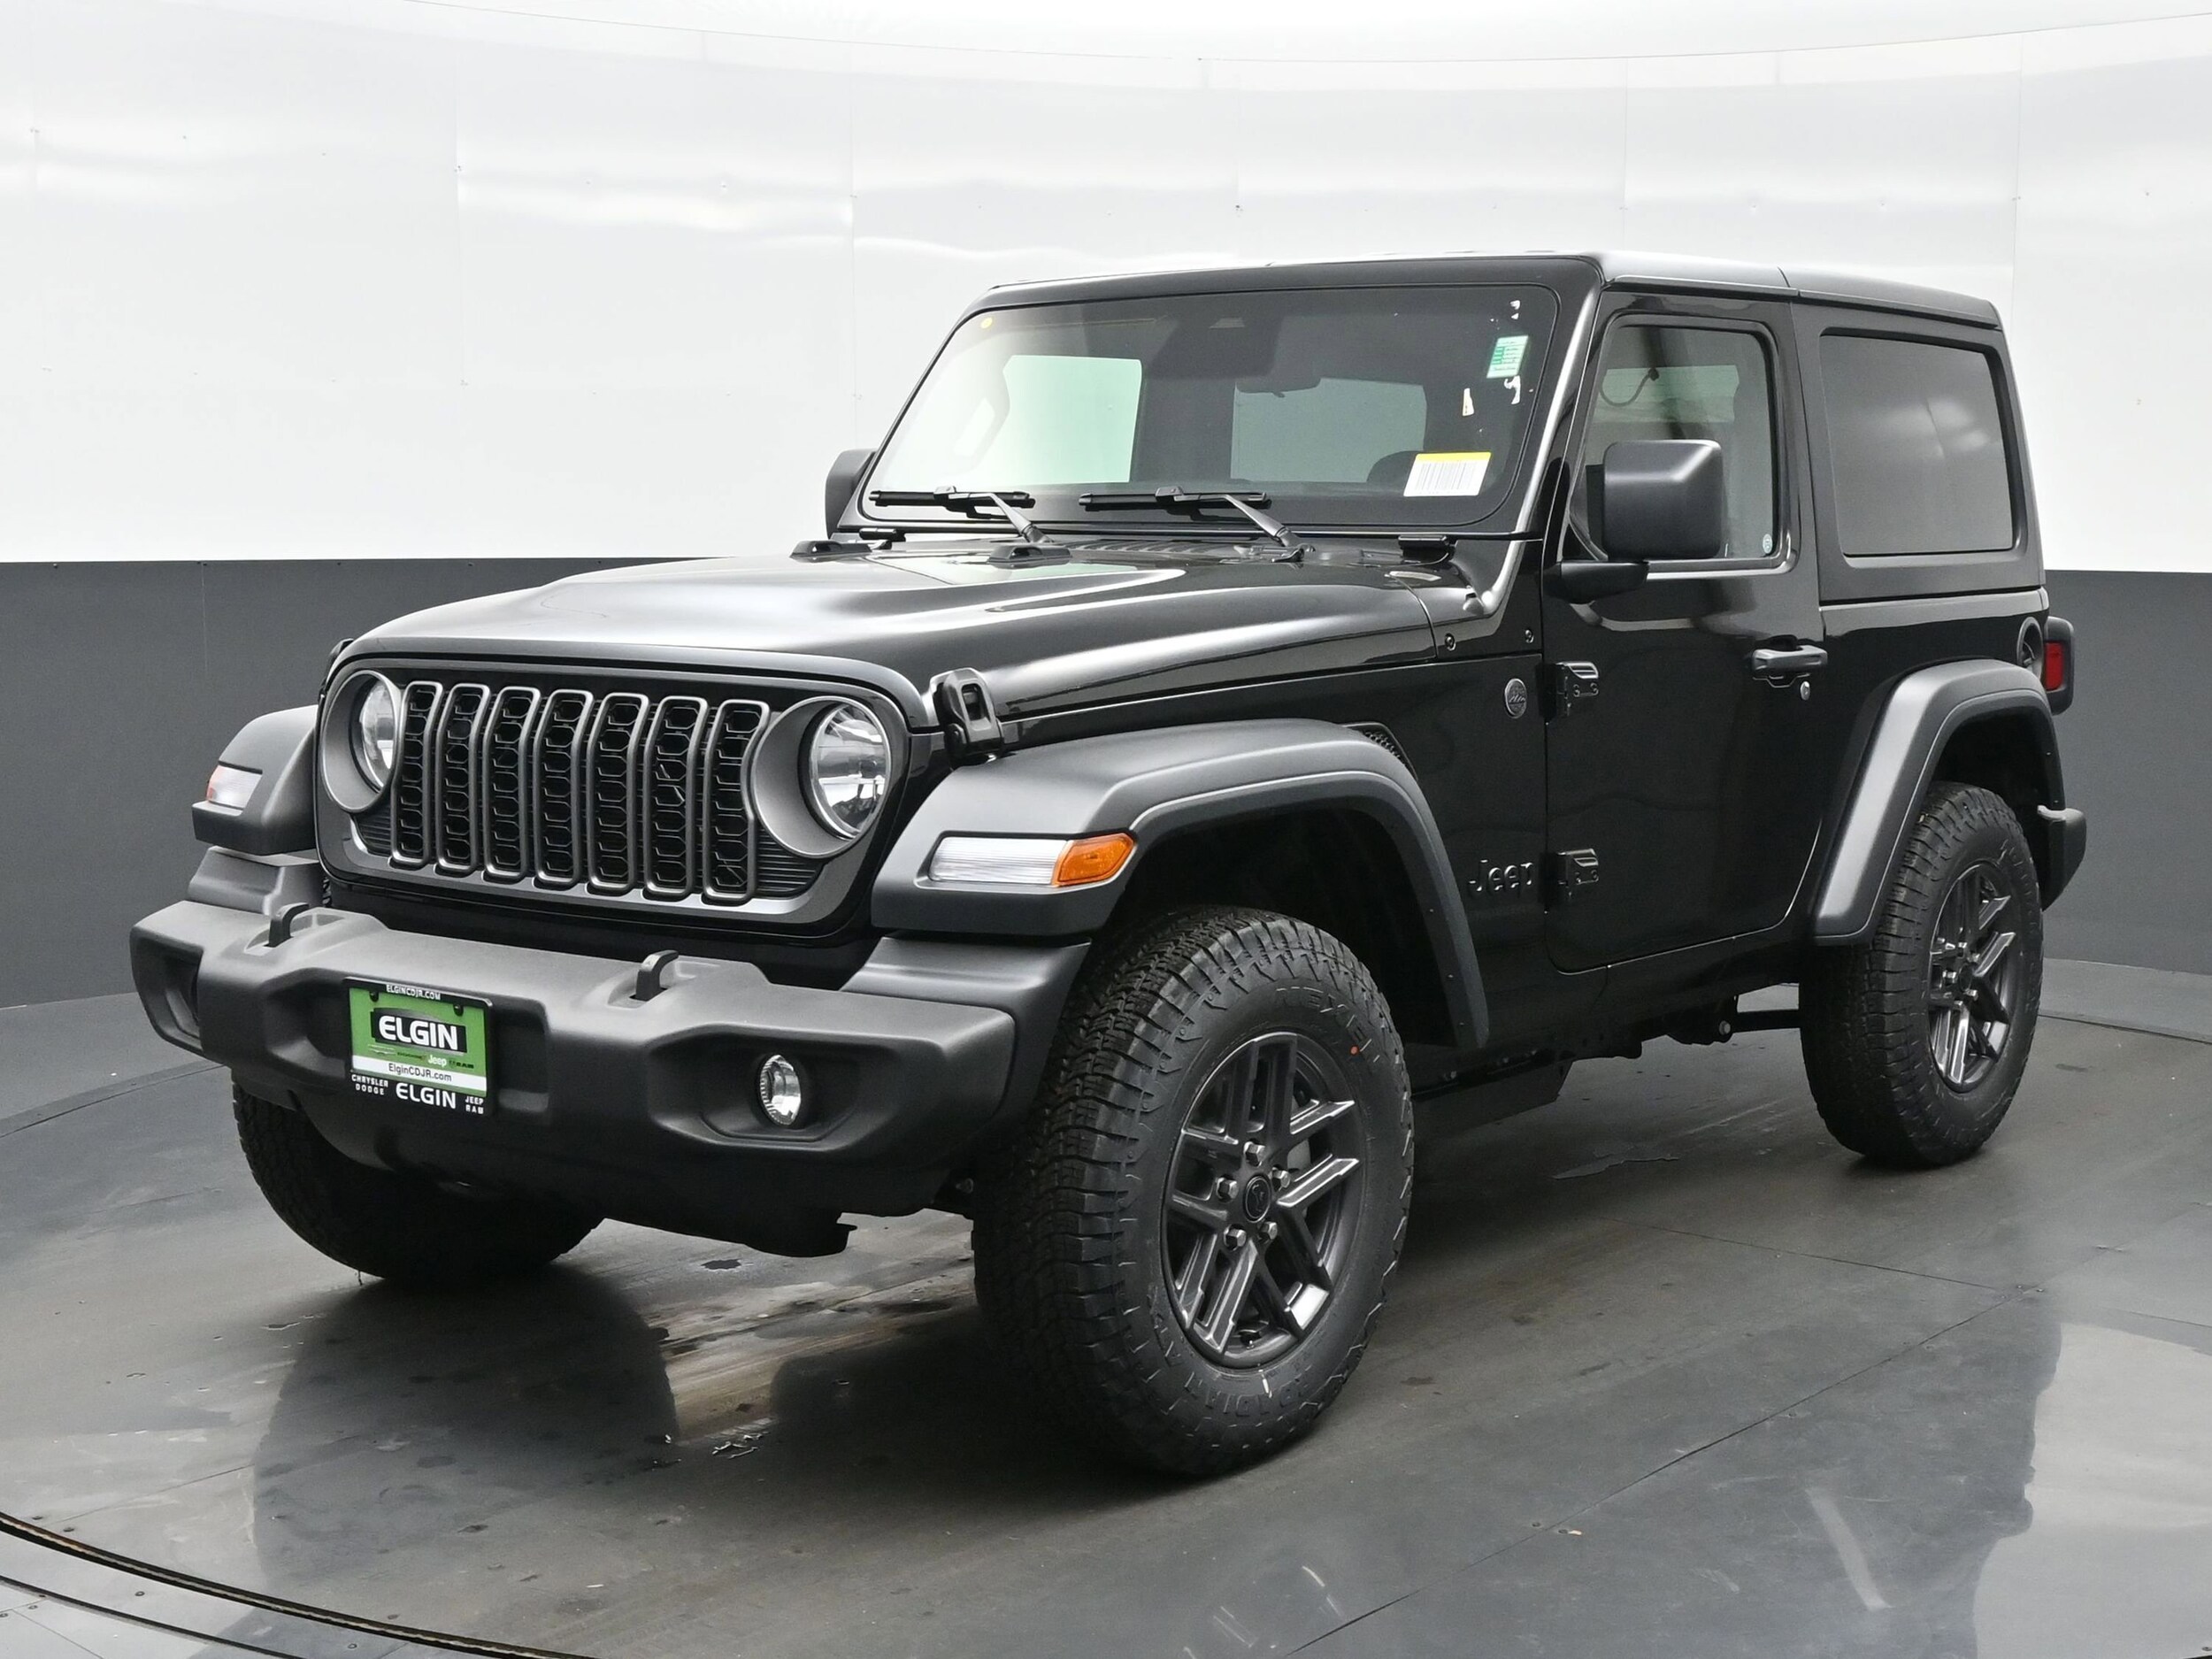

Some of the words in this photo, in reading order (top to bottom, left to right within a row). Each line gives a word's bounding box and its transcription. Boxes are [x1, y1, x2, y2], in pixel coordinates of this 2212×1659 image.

[386, 985, 441, 1000] ELGINCDJR.COM
[379, 1015, 457, 1050] ELGIN
[428, 1055, 447, 1068] Jeep
[388, 1064, 452, 1082] ElginCDJR.com
[351, 1074, 388, 1087] CHRYSLER
[356, 1083, 384, 1095] DODGE
[396, 1083, 456, 1109] ELGIN
[465, 1095, 484, 1104] JEEP
[465, 1104, 484, 1114] RAM
